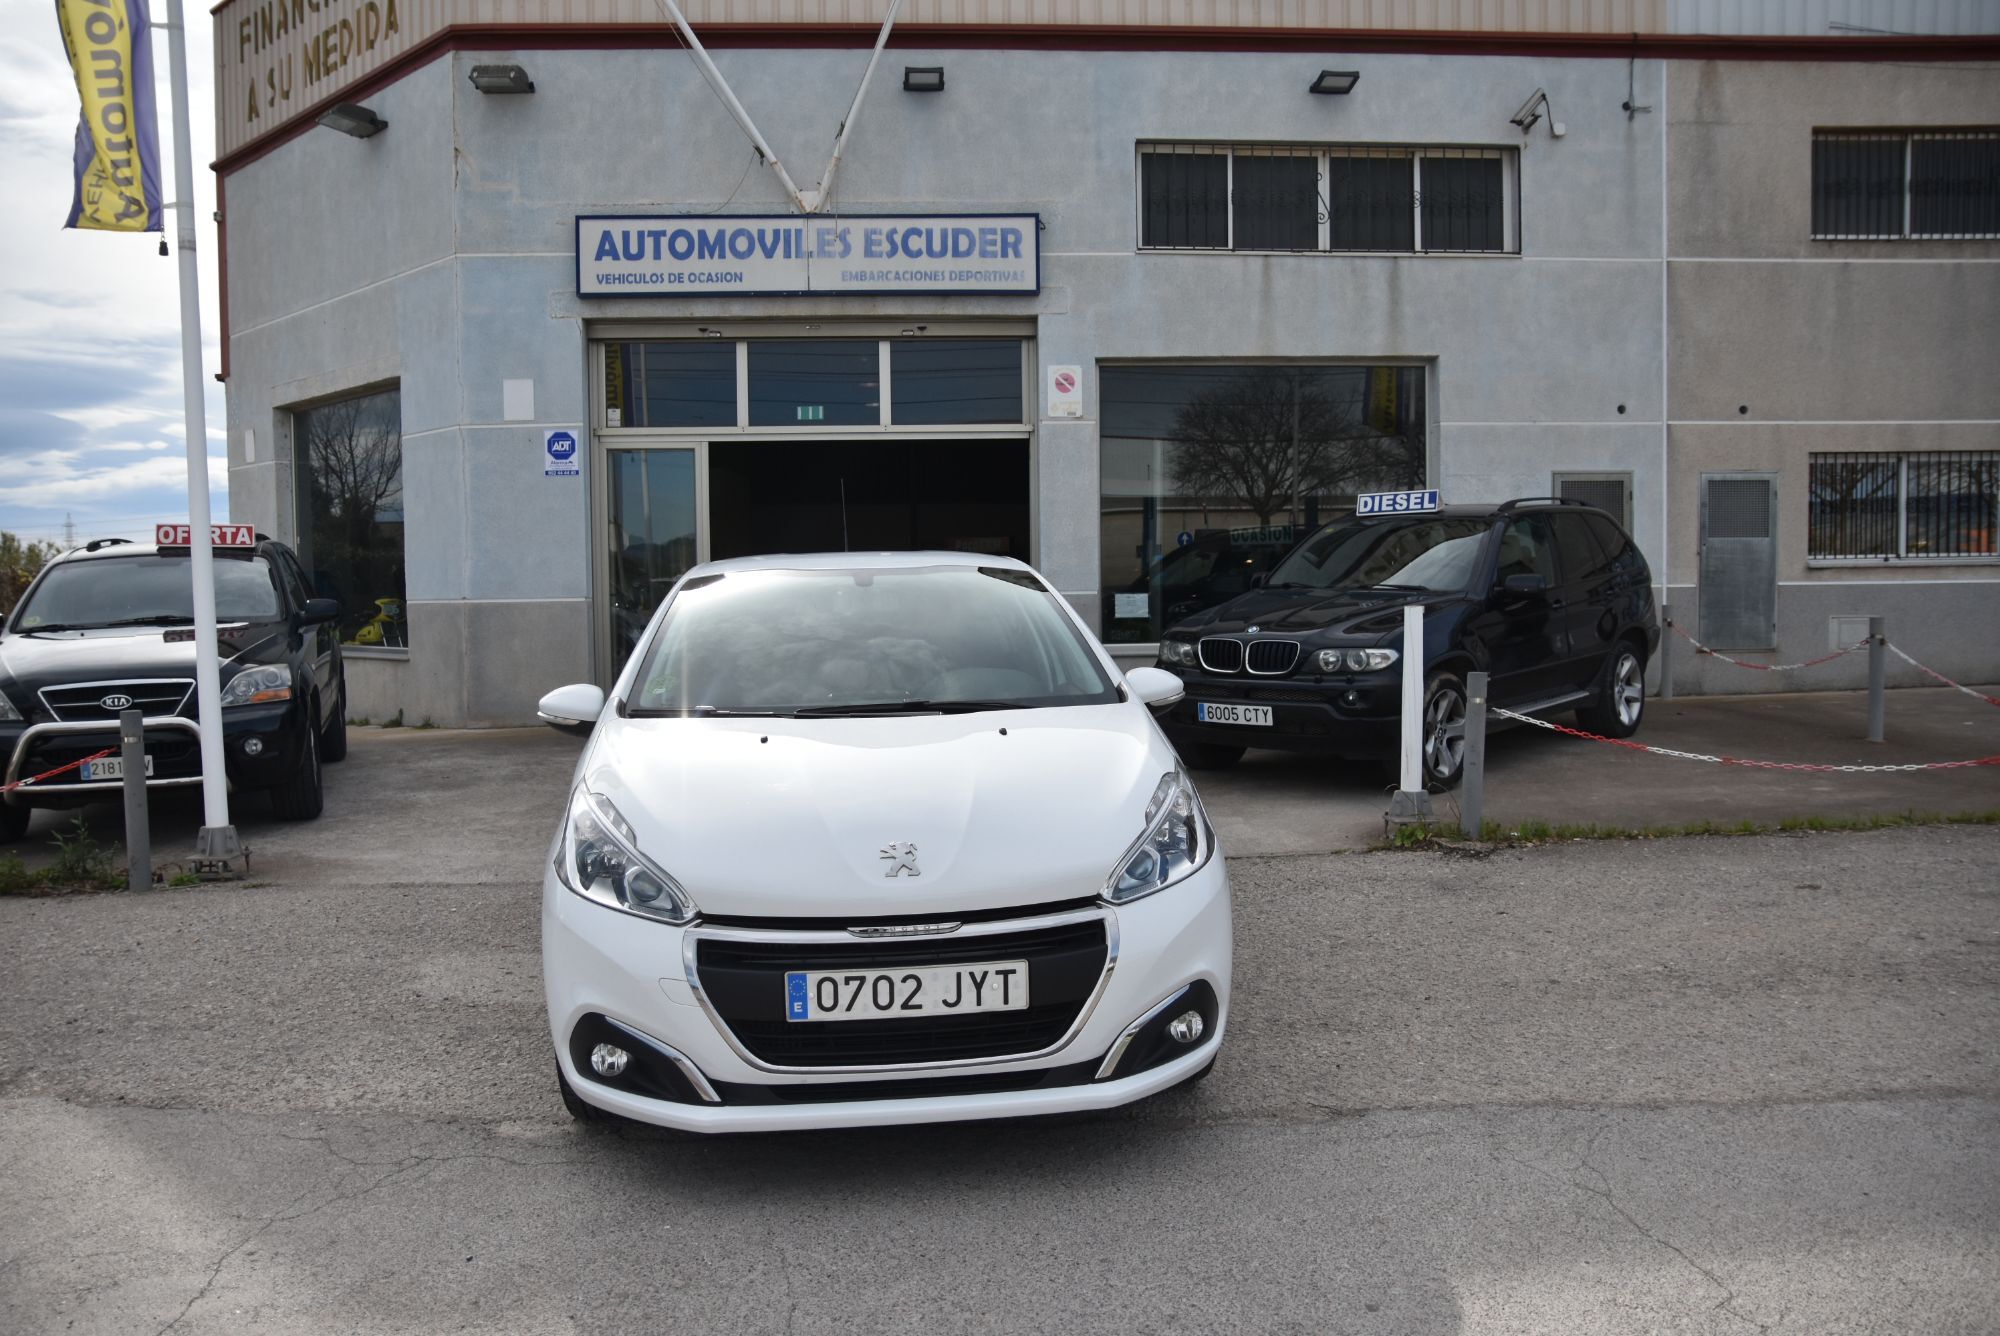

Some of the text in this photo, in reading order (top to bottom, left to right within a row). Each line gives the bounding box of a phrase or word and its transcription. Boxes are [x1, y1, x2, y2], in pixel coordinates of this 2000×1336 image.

[247, 0, 399, 122] A SU MEDIDA
[594, 227, 1023, 261] AUTOMOVILES ESCUDER
[596, 270, 1025, 285] VEHICULOS DE OCASION EMBARCACIONES DEPORTIVAS
[551, 440, 572, 451] ADT
[1358, 492, 1436, 513] DIESEL
[158, 526, 252, 545] OFRTA
[105, 698, 127, 707] KIA
[1207, 705, 1269, 723] 6005 CTY
[91, 761, 122, 776] 2181
[816, 968, 1017, 1012] 0702 JYT
[794, 1001, 803, 1012] E
